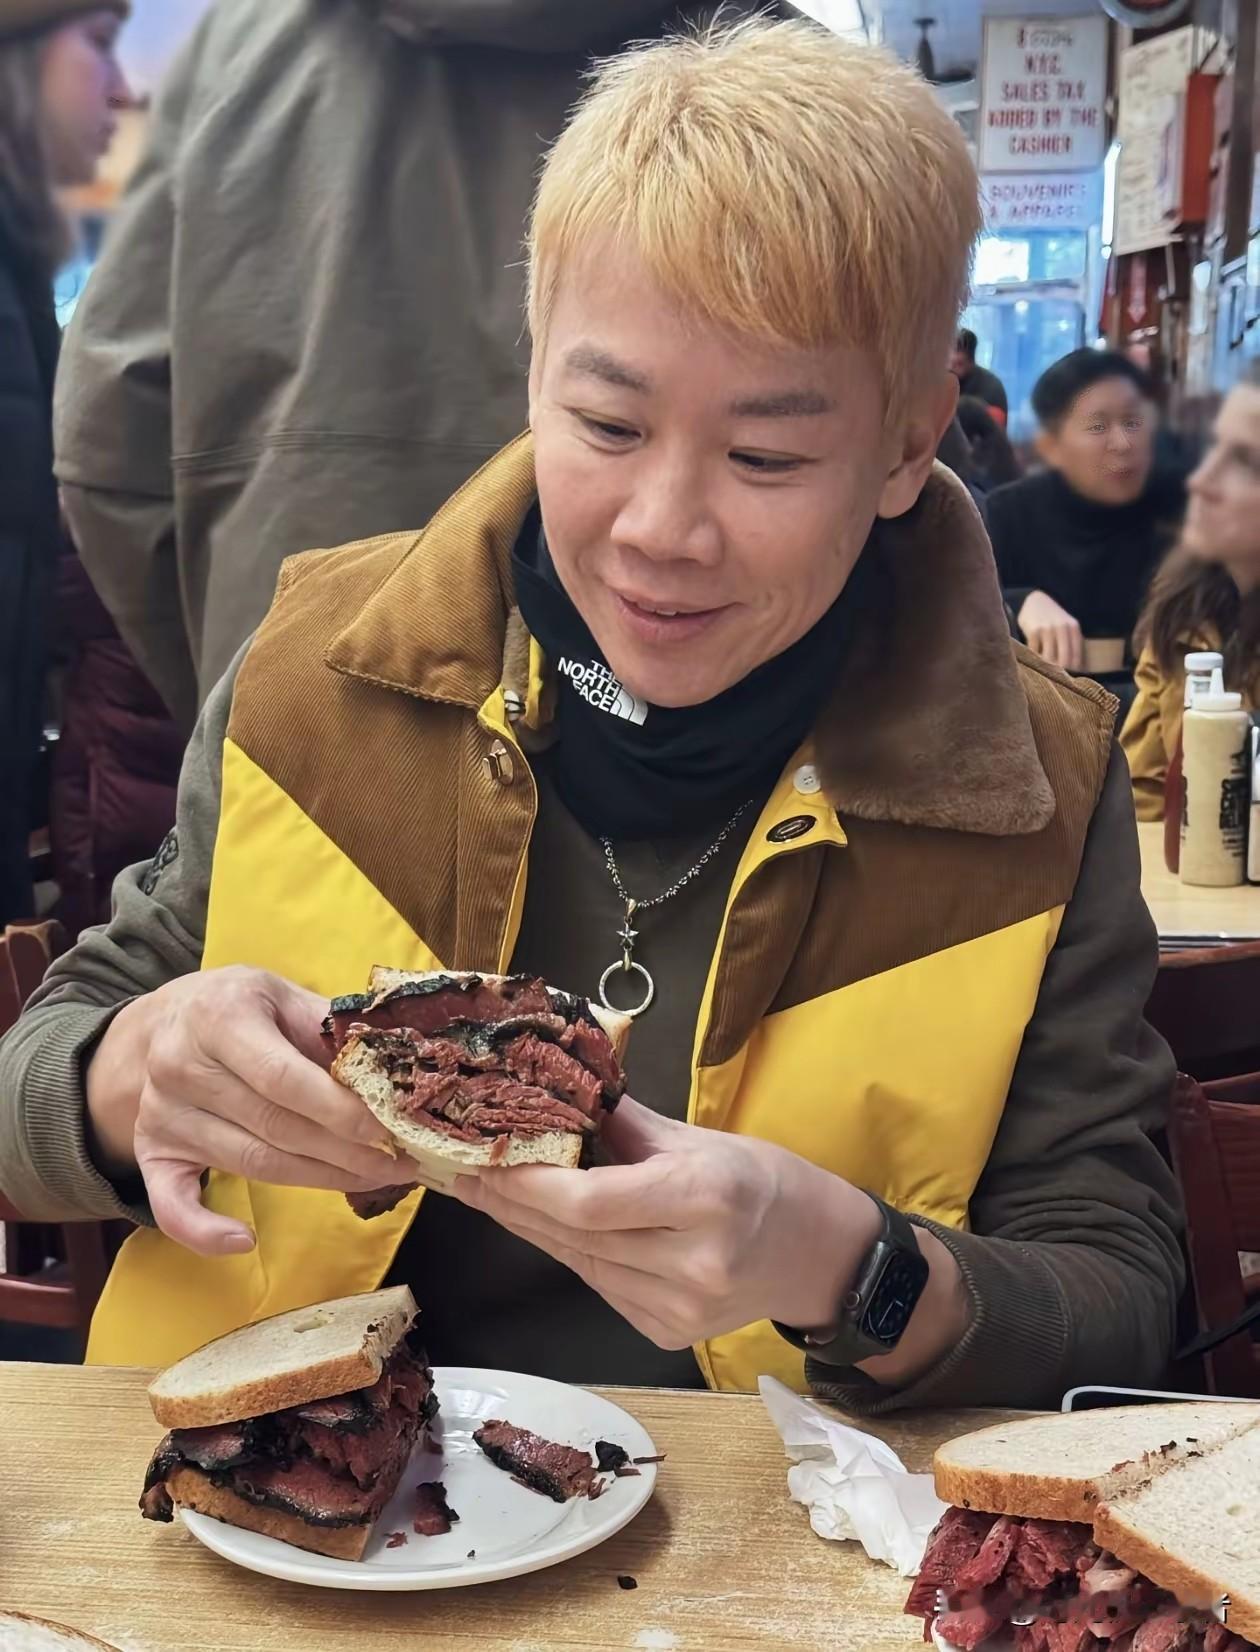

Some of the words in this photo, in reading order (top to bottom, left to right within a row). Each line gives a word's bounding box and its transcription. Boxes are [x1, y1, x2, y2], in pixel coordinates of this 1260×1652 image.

[557, 656, 620, 698] NORTH
[591, 659, 623, 686] THE
[572, 679, 615, 712] FACE
